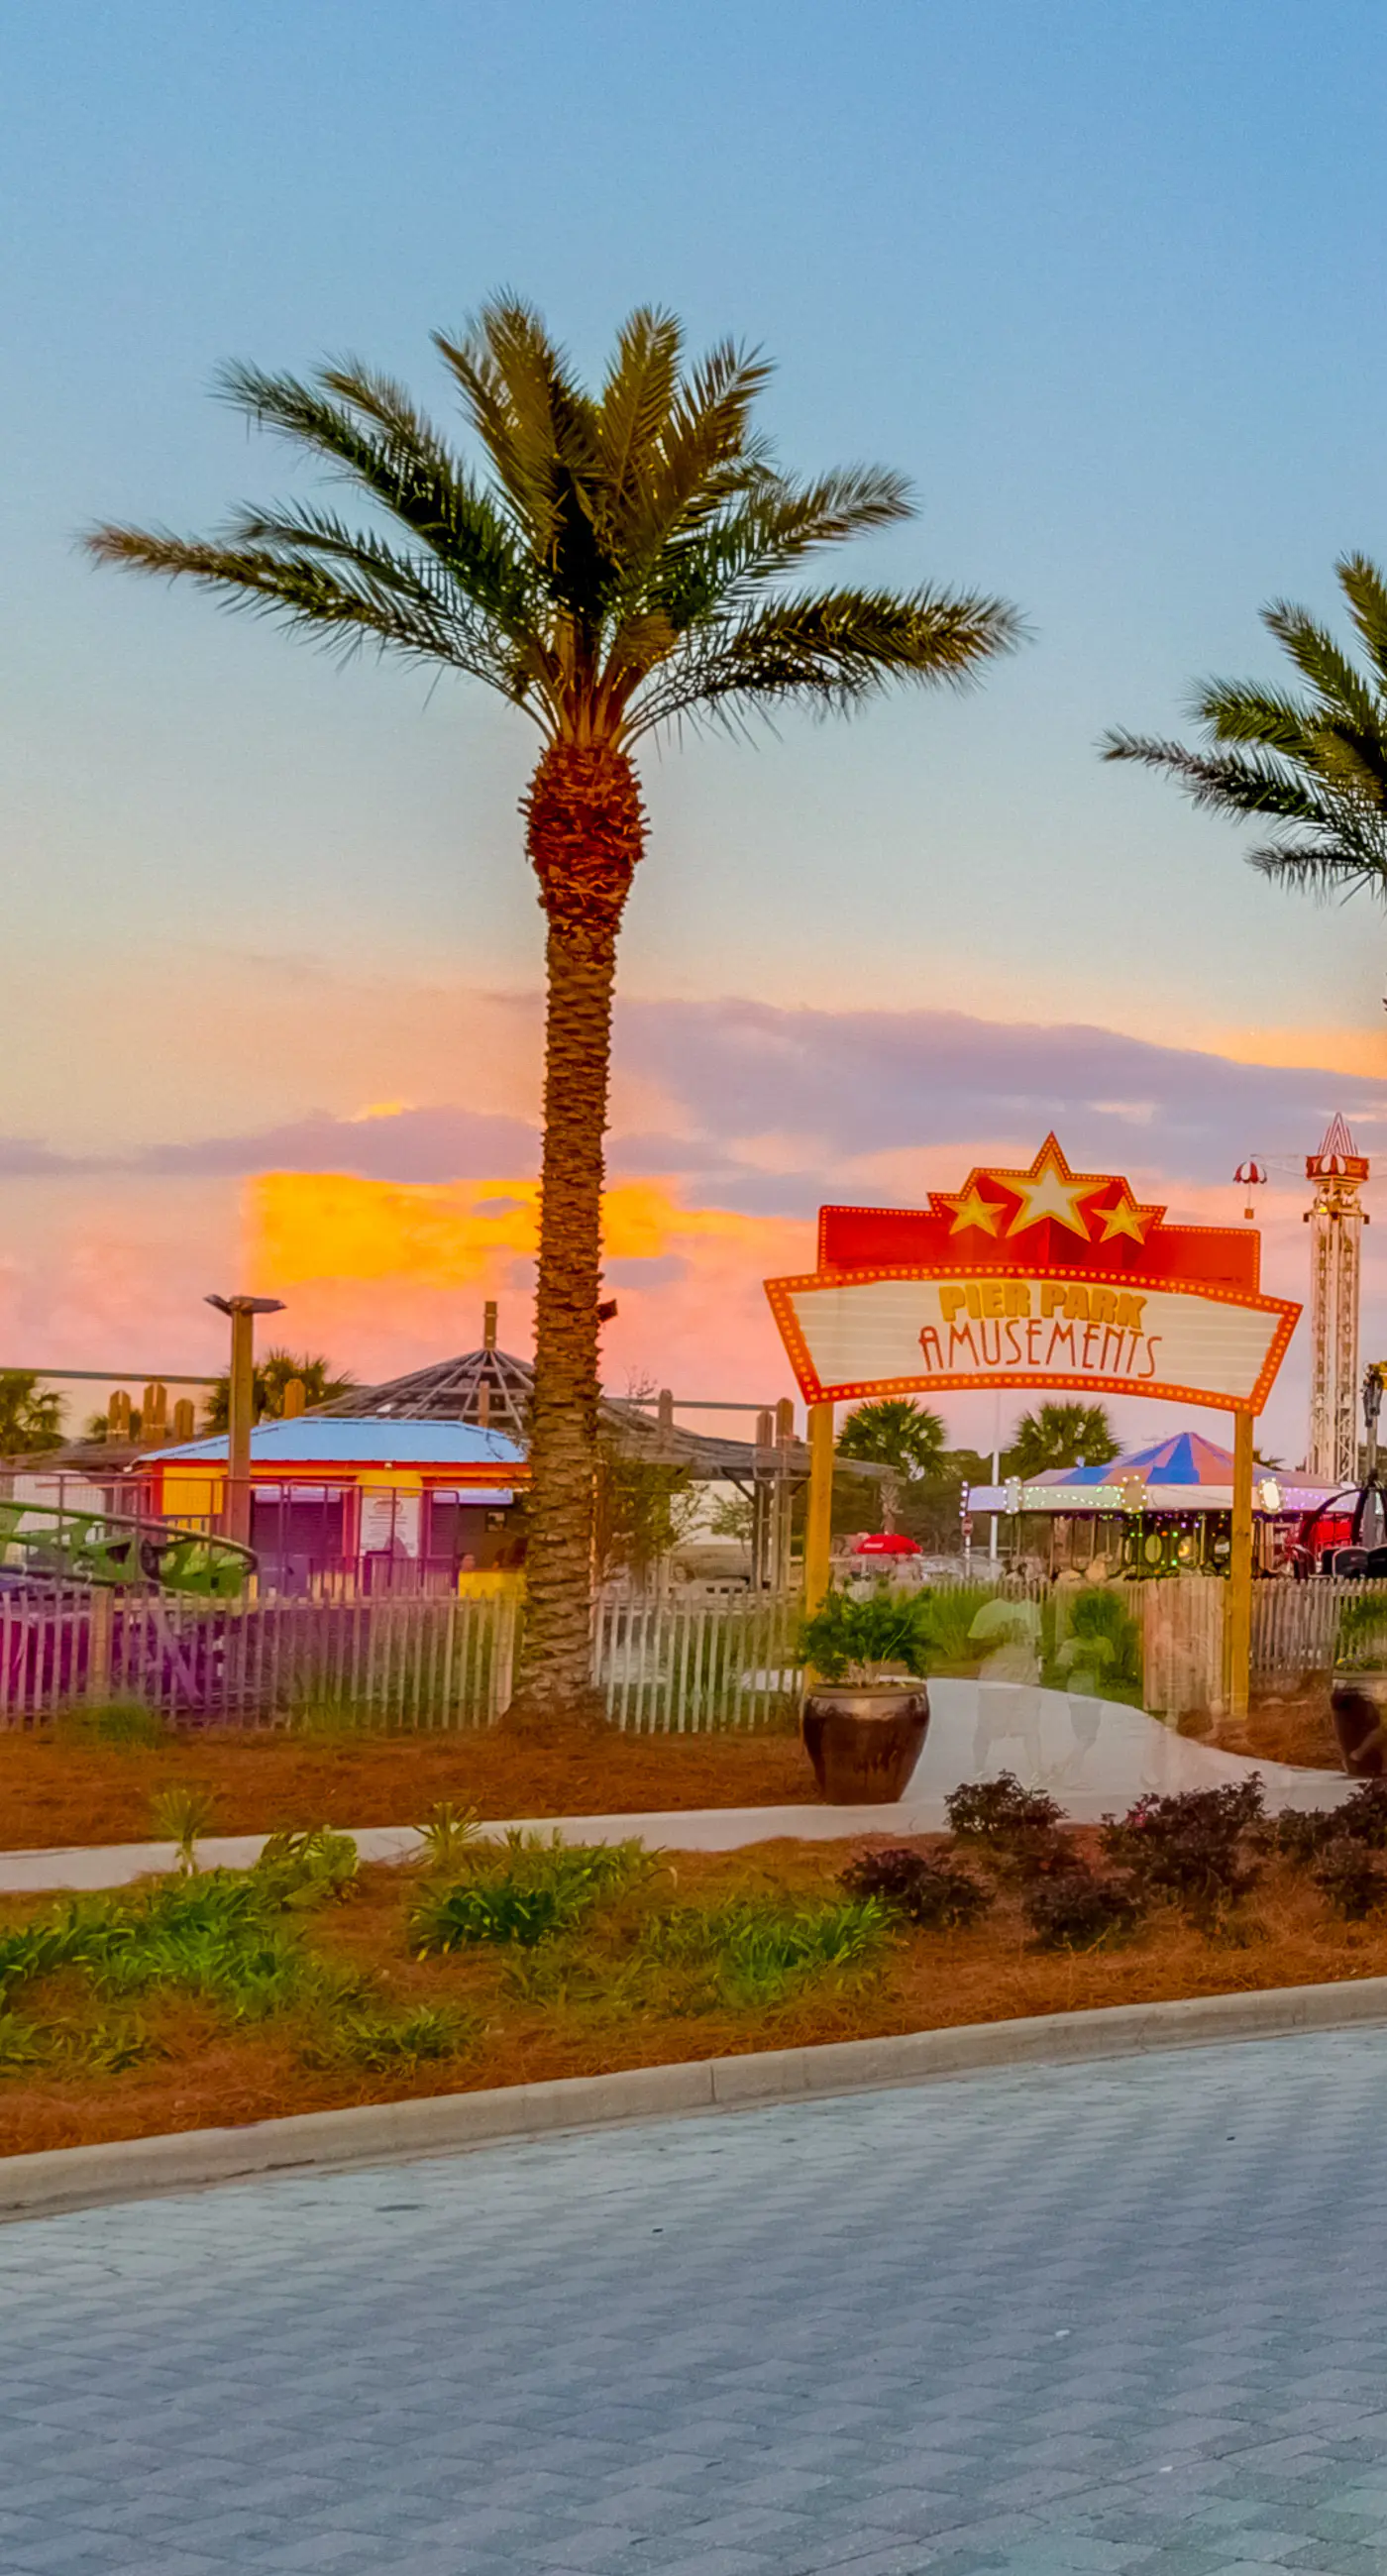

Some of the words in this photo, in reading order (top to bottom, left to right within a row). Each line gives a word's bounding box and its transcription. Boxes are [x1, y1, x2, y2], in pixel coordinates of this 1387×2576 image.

[939, 1282, 1031, 1322] PIER
[1040, 1283, 1147, 1329] PARK
[918, 1319, 1163, 1378] AMUSEMENTS
